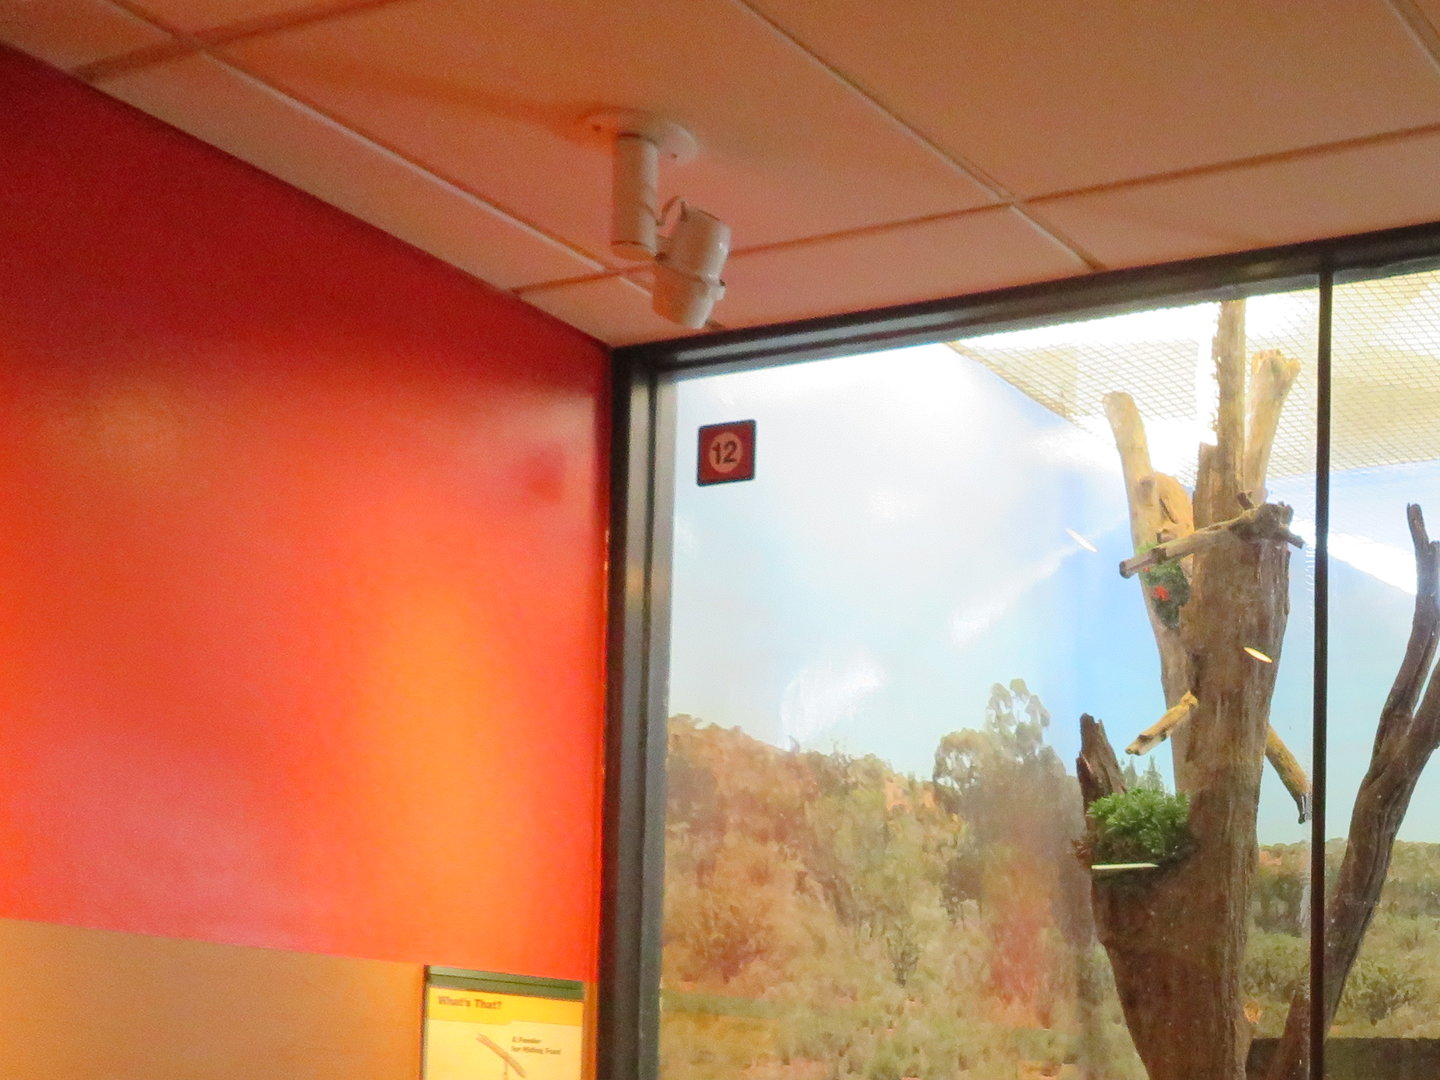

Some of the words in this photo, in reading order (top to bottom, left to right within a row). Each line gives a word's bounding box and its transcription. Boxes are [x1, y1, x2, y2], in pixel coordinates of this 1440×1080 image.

[711, 440, 737, 465] 12
[438, 996, 471, 1007] What's
[474, 998, 502, 1010] That?
